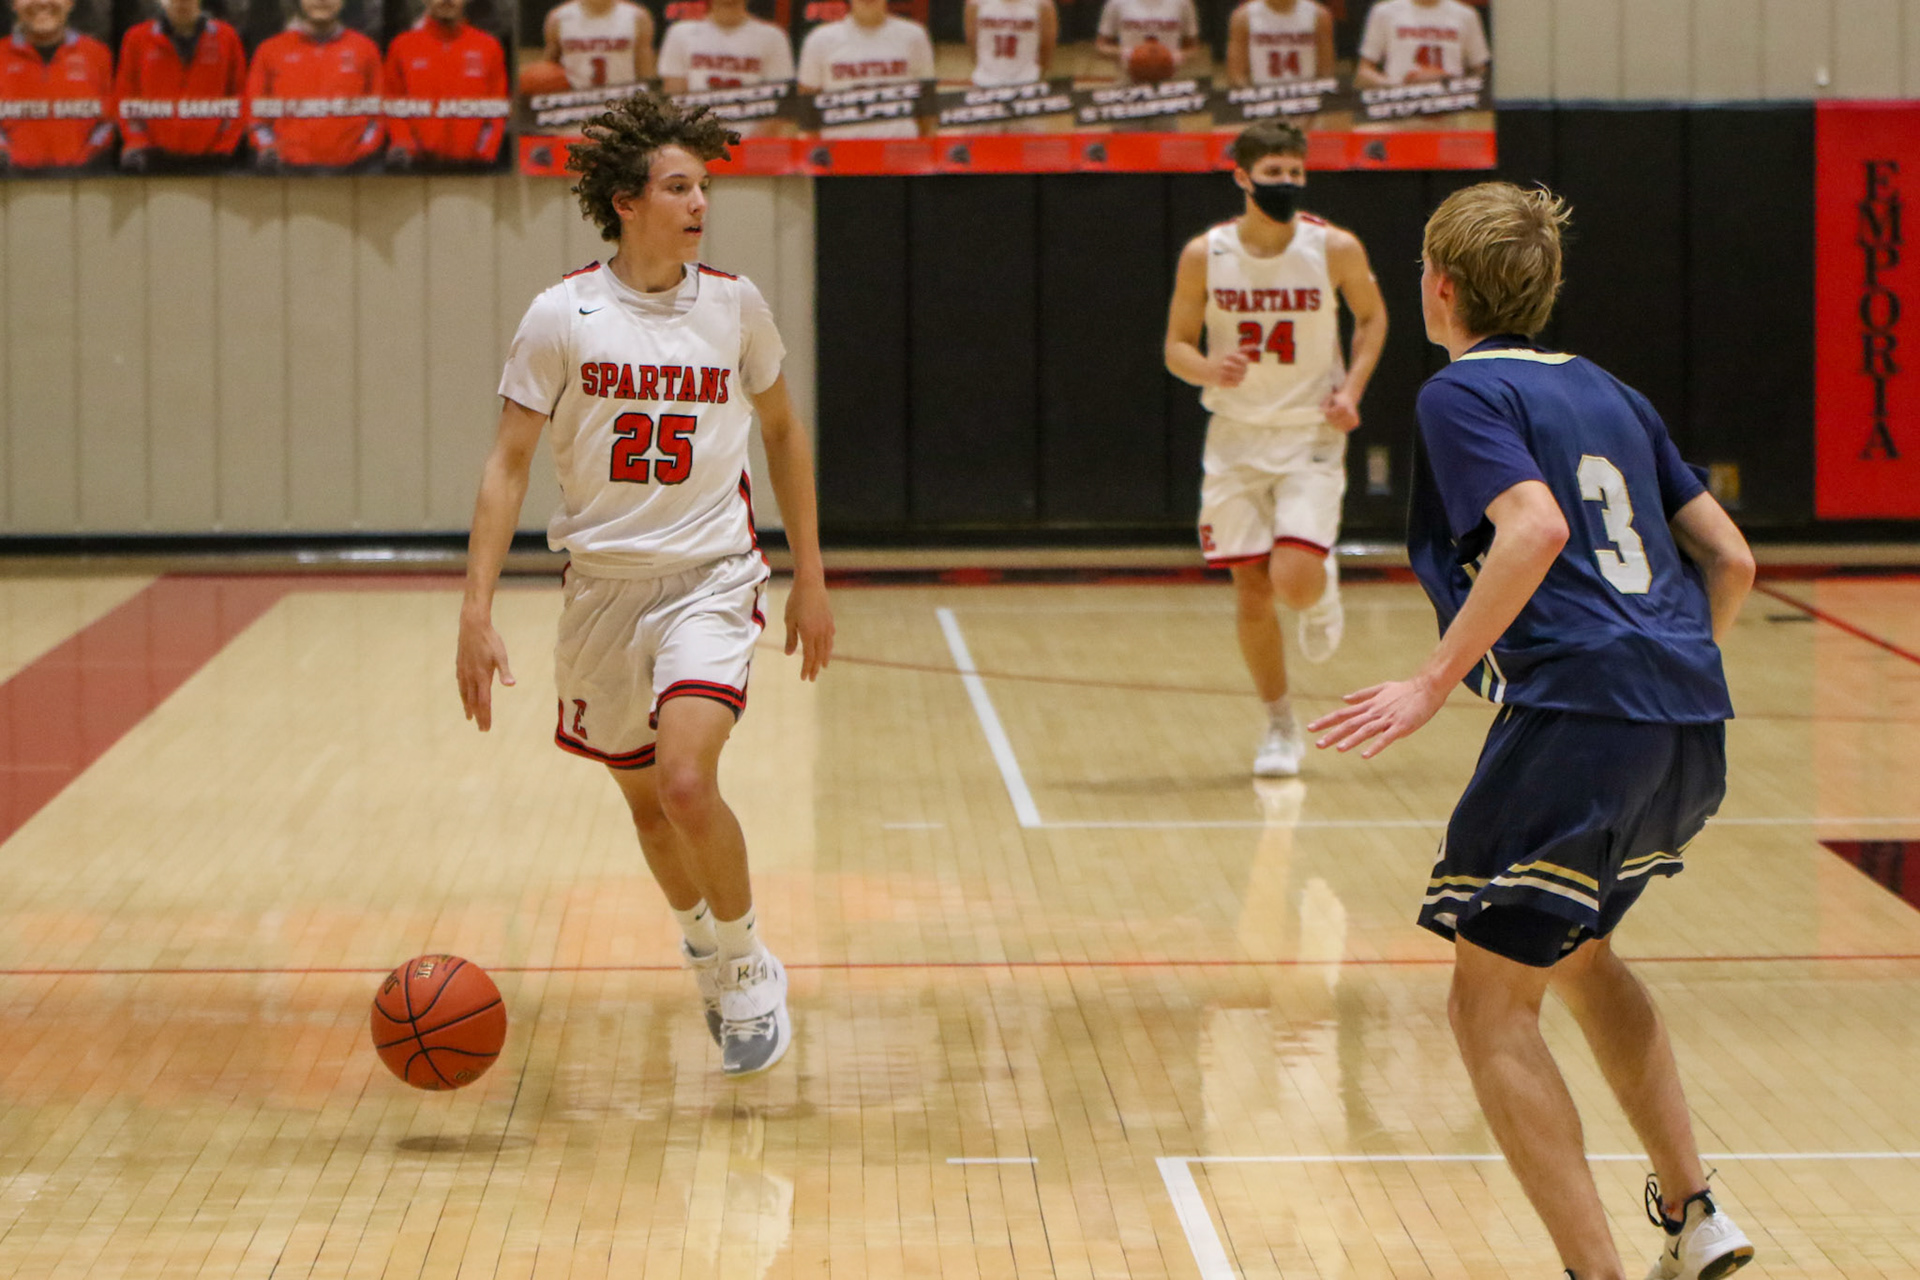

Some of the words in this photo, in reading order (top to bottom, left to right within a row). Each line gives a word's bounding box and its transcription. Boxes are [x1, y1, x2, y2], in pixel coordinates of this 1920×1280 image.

[1079, 94, 1206, 122] STEWART
[1228, 78, 1338, 103] HUNTER
[1361, 76, 1484, 103] CHARLES
[1213, 288, 1321, 313] SPARTANS
[1858, 160, 1904, 460] EMPORIA
[1237, 320, 1296, 365] 24
[581, 361, 731, 404] SPARTANS
[609, 411, 698, 486] 25
[1577, 453, 1652, 595] 3
